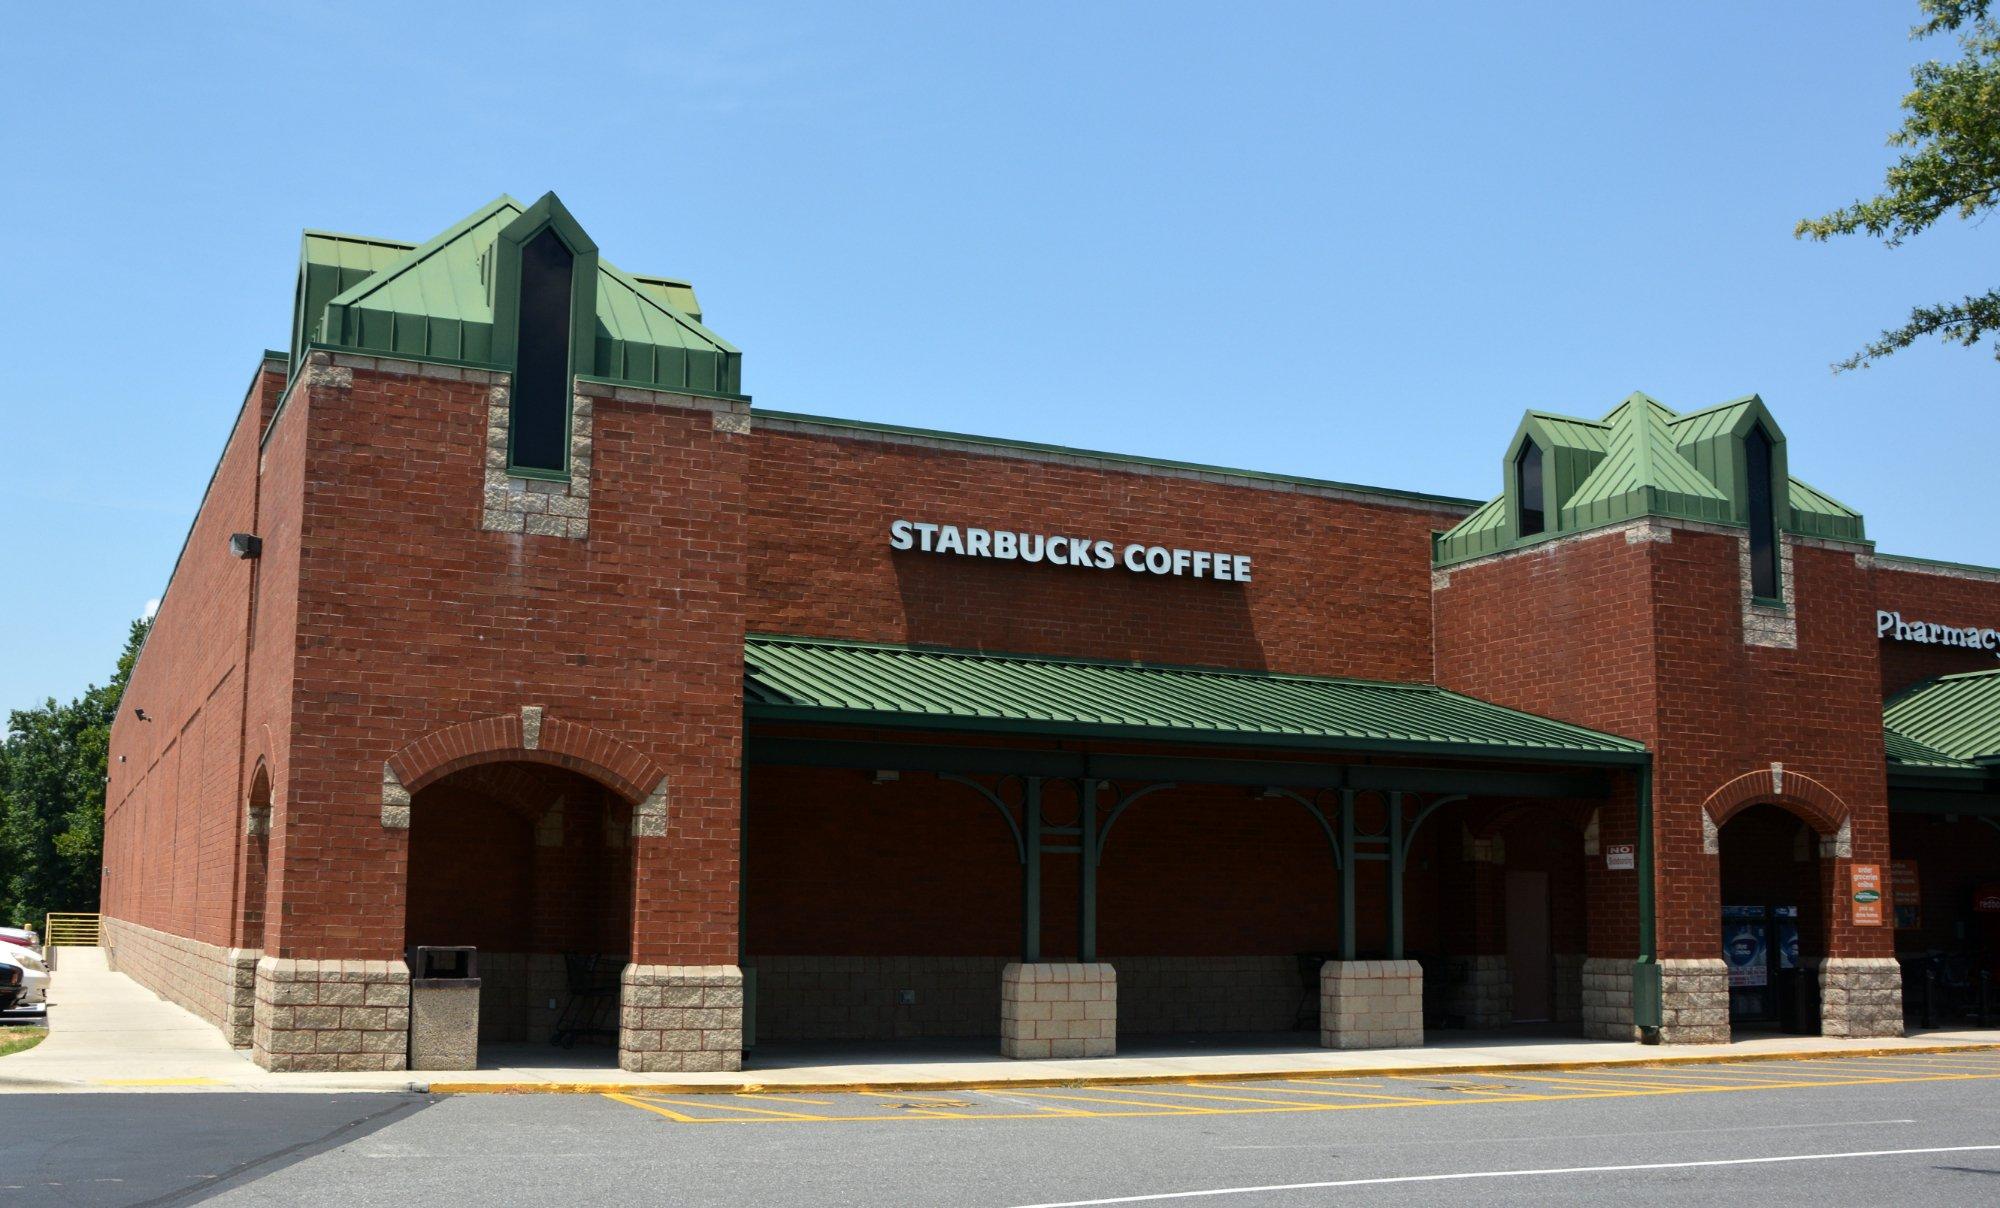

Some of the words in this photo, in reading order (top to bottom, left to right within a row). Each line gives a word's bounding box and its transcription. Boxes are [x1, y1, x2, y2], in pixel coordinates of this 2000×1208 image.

[889, 519, 1114, 569] STARBUCKS
[1123, 543, 1252, 582] COFFEE
[1610, 846, 1630, 854] NO
